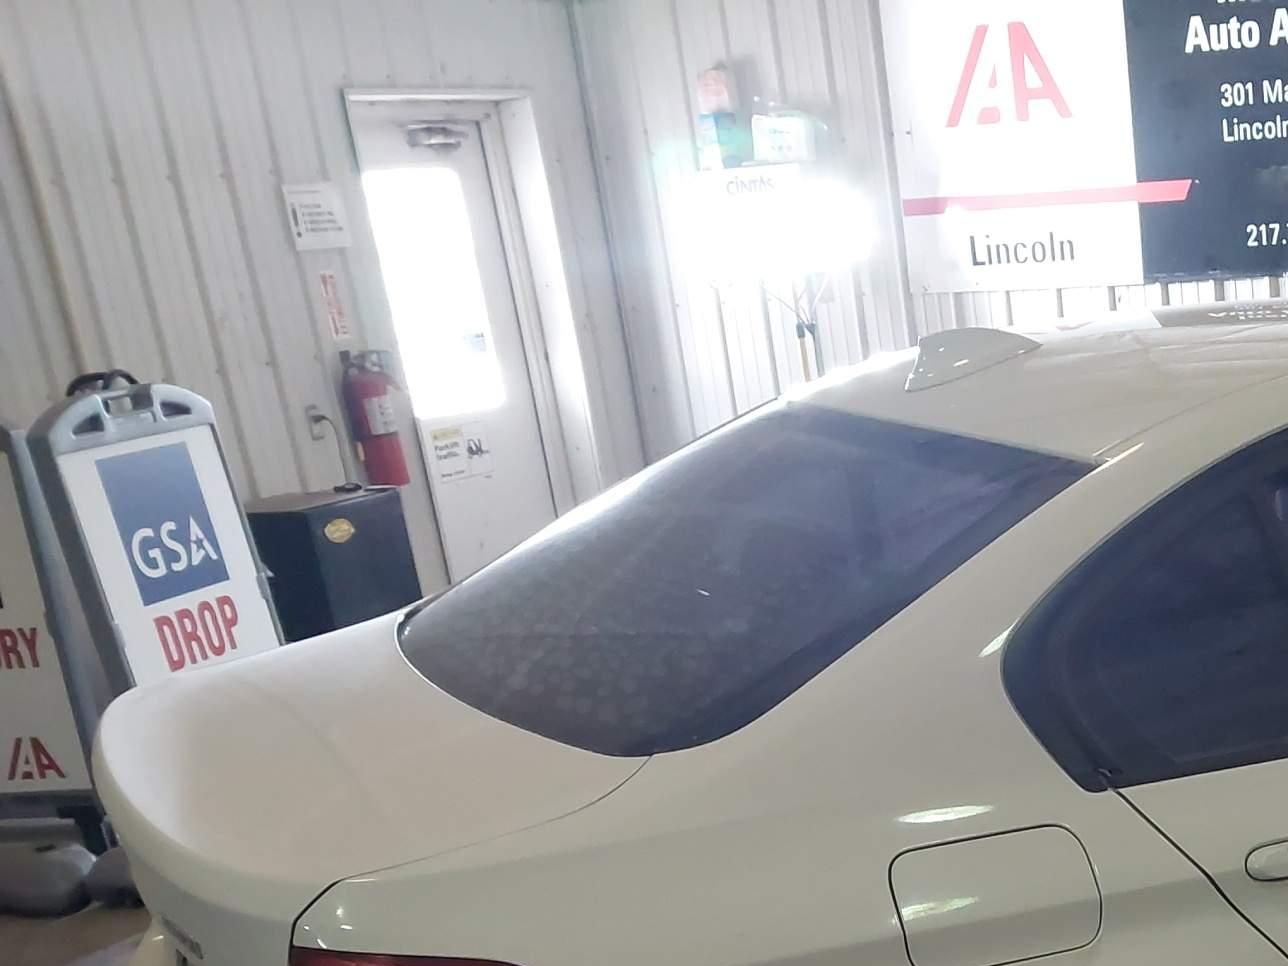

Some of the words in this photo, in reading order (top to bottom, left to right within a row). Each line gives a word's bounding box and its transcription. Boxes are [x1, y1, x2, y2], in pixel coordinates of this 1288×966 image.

[1184, 15, 1260, 53] Auto
[1220, 81, 1254, 107] 301
[969, 231, 1075, 266] Lincoln
[132, 515, 218, 578] GSA
[0, 627, 40, 669] RY
[153, 595, 238, 672] DROP
